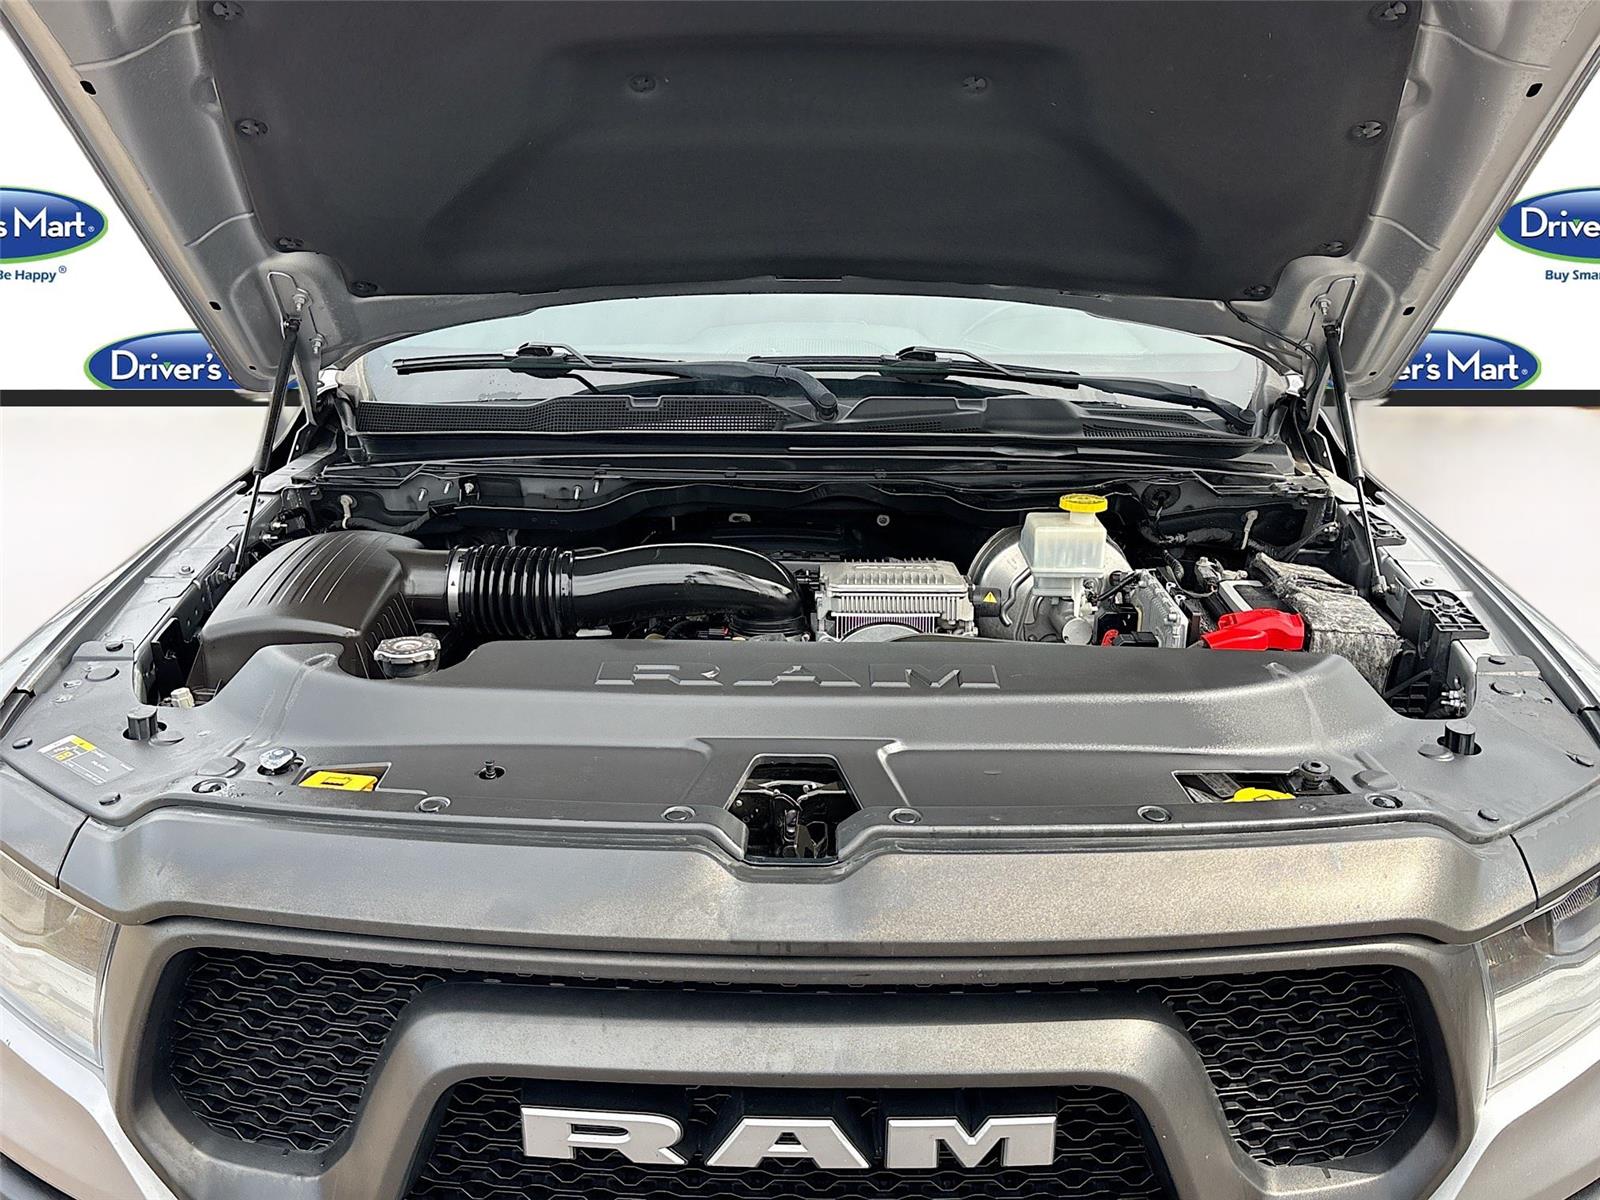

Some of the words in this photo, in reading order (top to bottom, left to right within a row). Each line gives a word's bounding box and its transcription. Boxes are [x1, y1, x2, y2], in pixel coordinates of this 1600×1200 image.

[14, 206, 86, 238] Mart
[15, 269, 57, 283] Happy
[1545, 269, 1569, 283] Buy
[111, 349, 222, 380] Driver's
[1447, 349, 1519, 380] Mart
[595, 661, 1000, 688] RAM
[520, 1105, 1057, 1169] RAM
